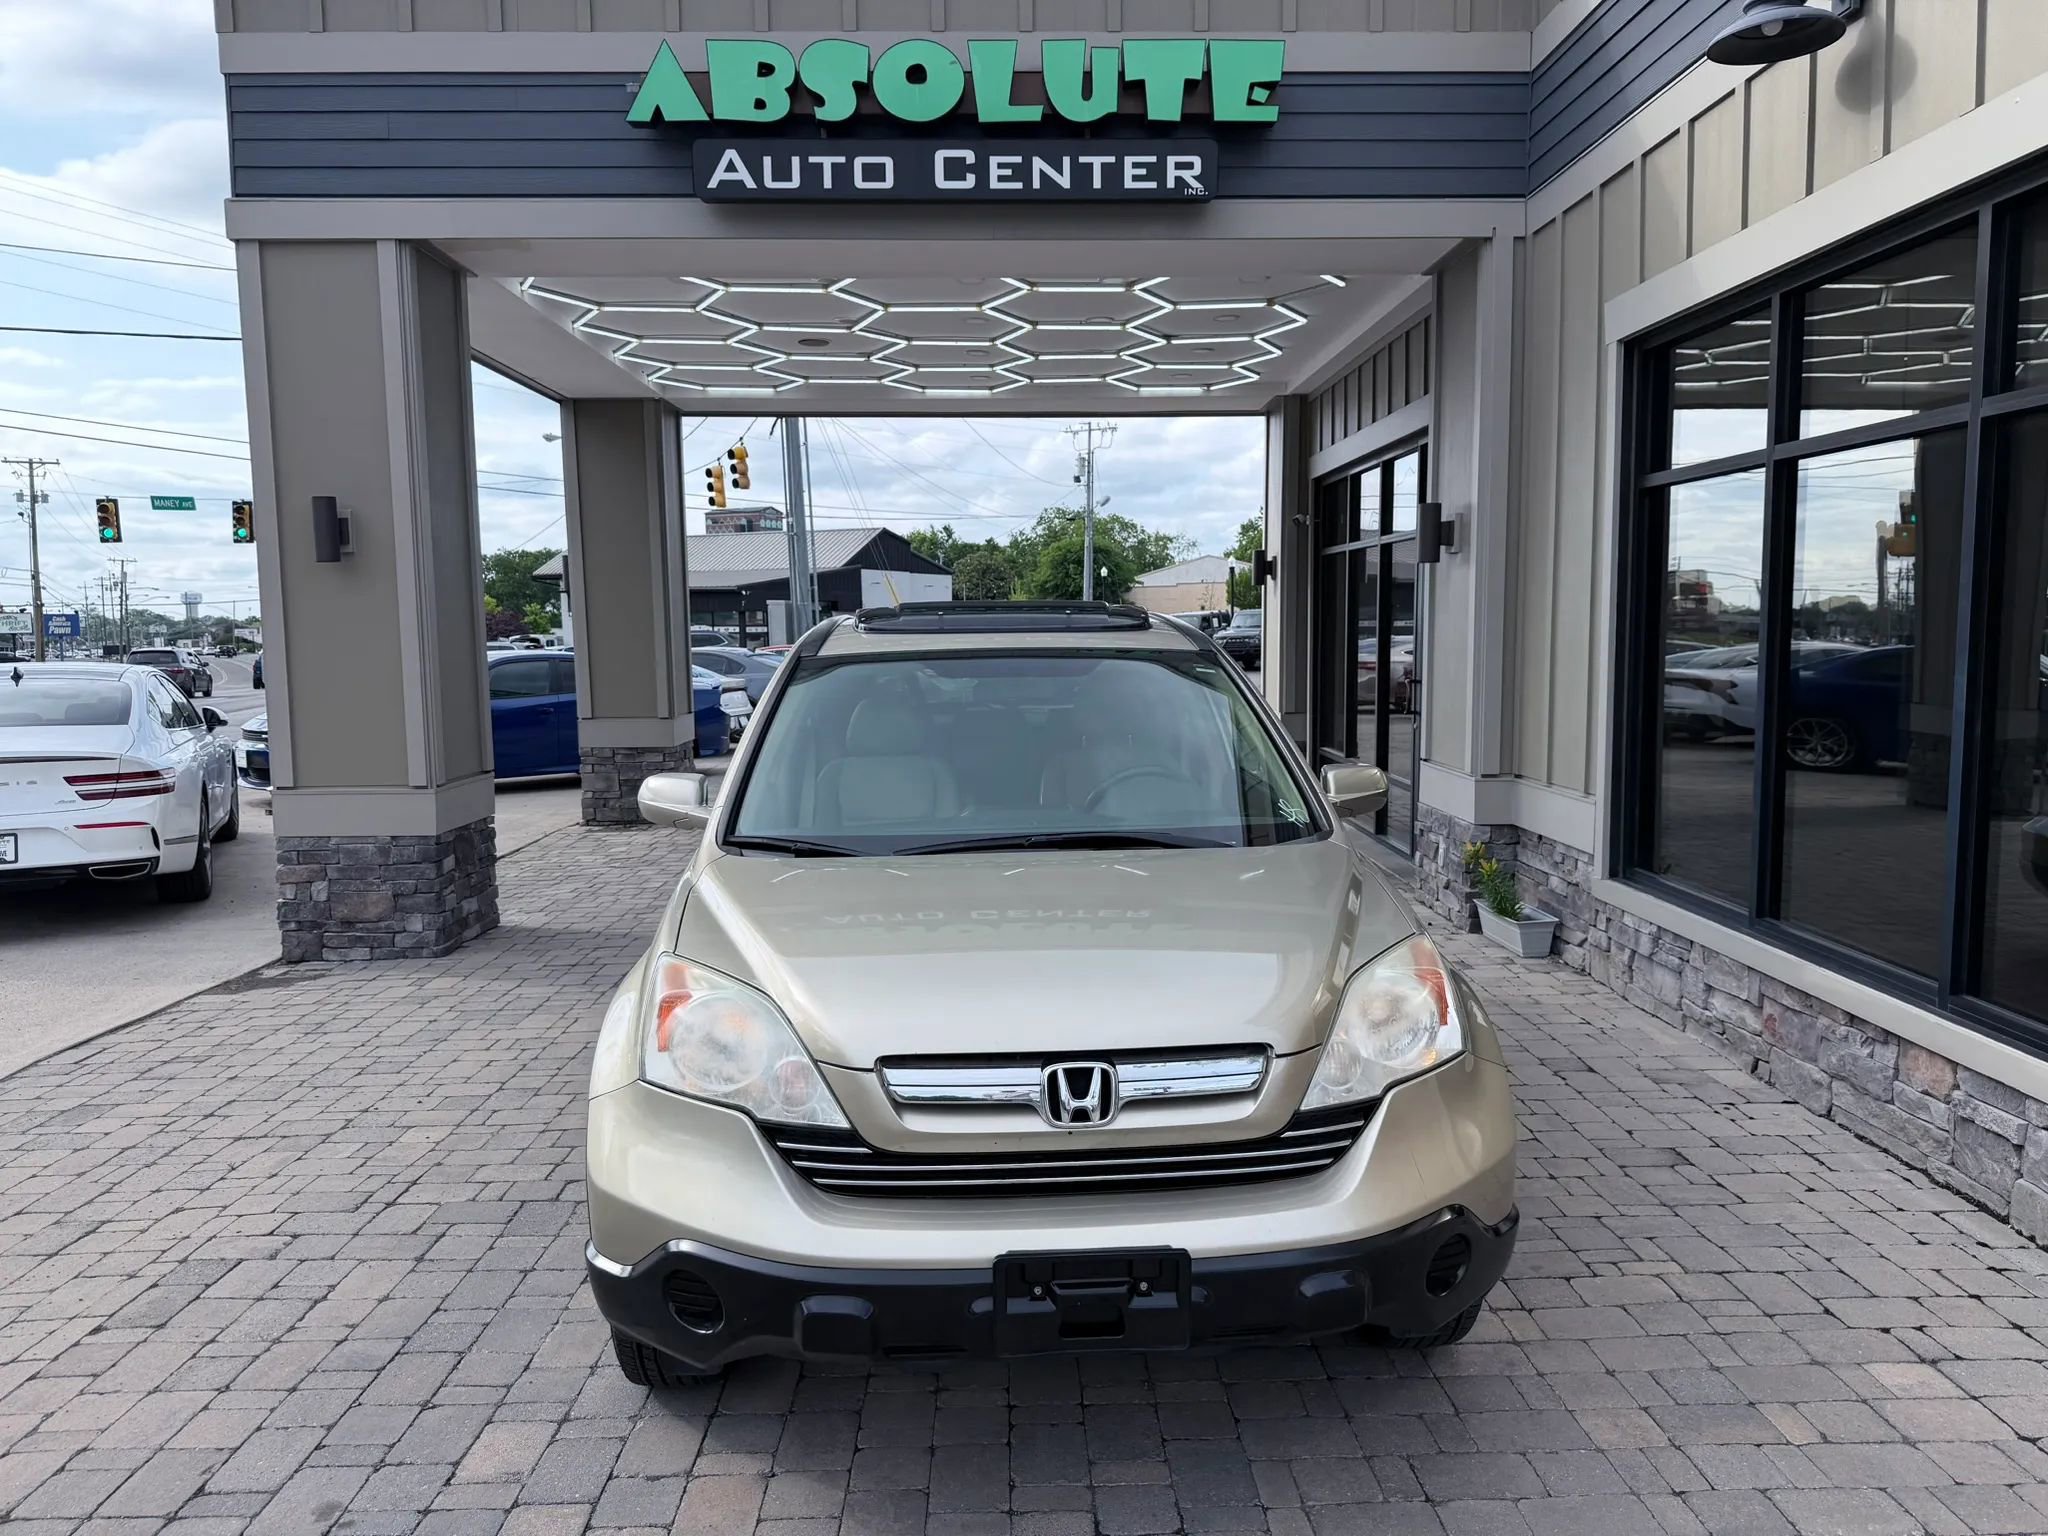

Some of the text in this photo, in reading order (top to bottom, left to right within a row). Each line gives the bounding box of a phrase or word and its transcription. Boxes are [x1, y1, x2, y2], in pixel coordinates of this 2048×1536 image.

[626, 38, 1286, 126] ABSOLUTE
[706, 148, 1204, 190] AUTO CENTER
[1184, 187, 1209, 196] INC.
[153, 499, 180, 508] MANEY
[48, 626, 71, 635] Pawn
